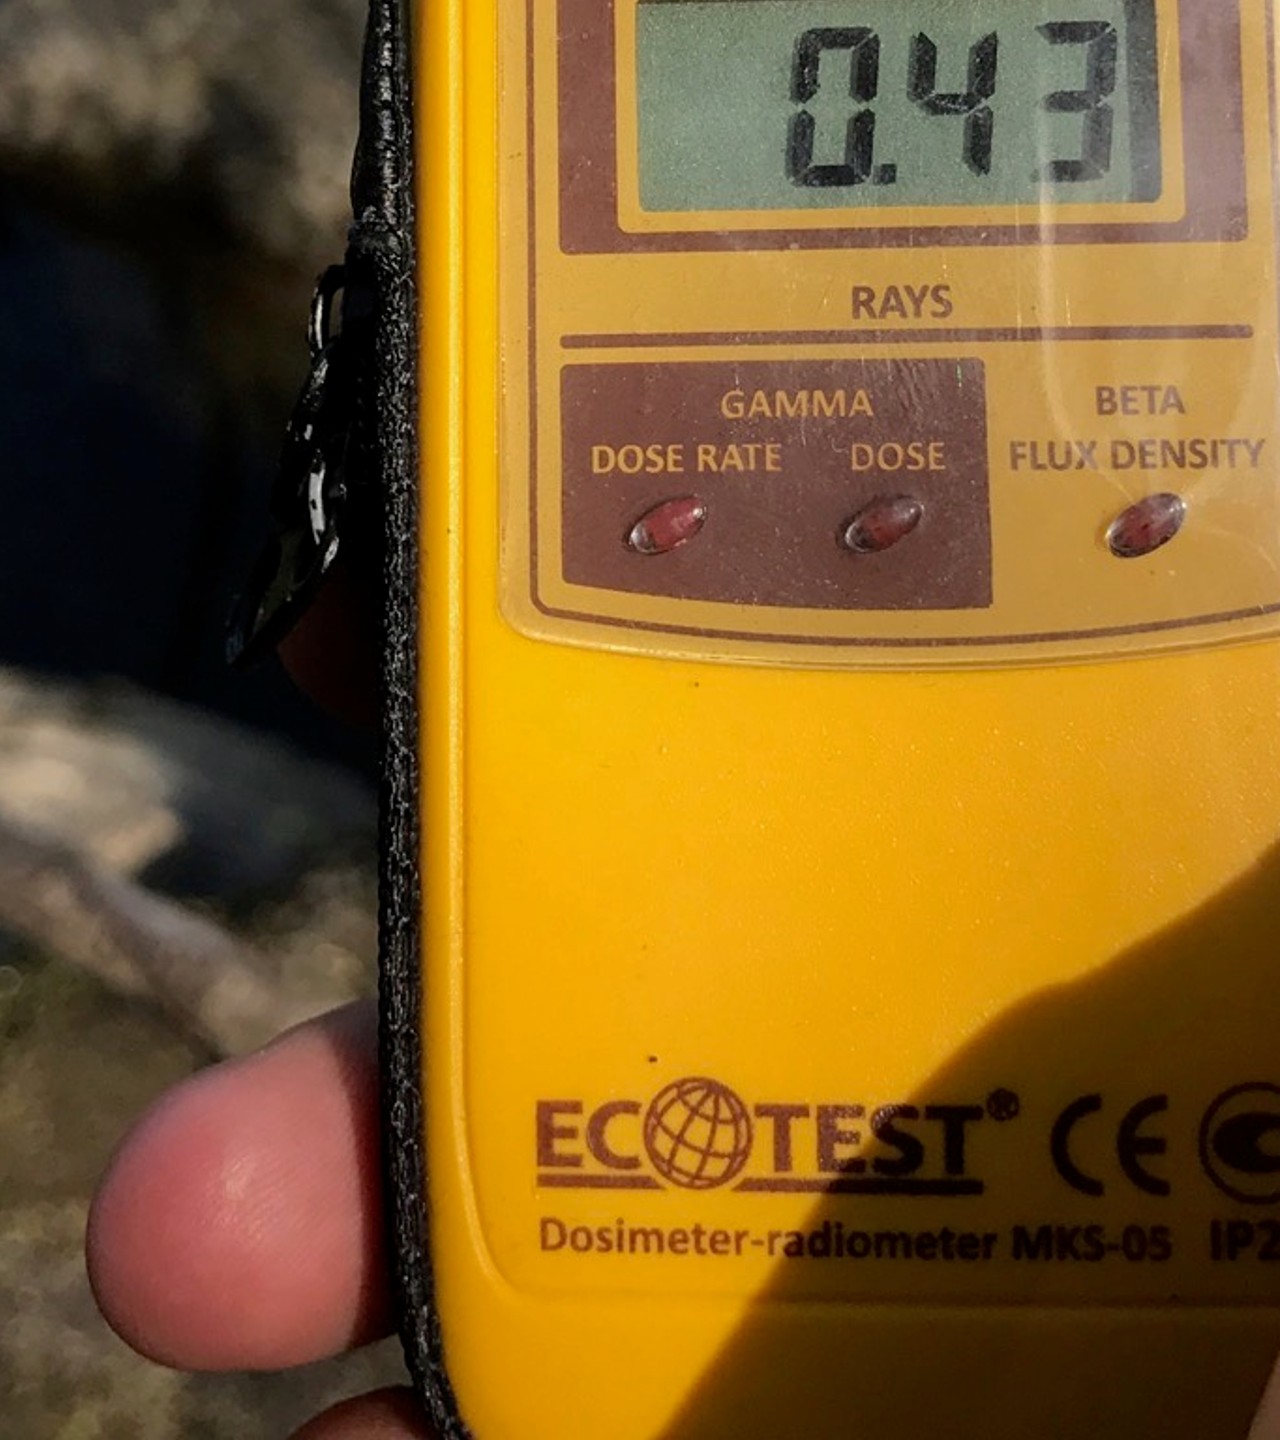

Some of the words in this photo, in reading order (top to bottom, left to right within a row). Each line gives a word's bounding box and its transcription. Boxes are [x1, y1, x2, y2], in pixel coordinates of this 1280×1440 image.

[785, 20, 1117, 188] 0.43
[851, 284, 954, 321] RAYS
[720, 388, 874, 421] GAMMA
[1094, 384, 1187, 417] BETA
[590, 444, 689, 475] DOSE
[696, 442, 783, 474] RATE
[850, 440, 946, 472] DOSE
[1008, 438, 1098, 472] FLUX
[1109, 436, 1266, 471] DENSITY
[538, 1217, 999, 1262] Dosimeter-radiometer
[1010, 1221, 1173, 1263] MKS-05
